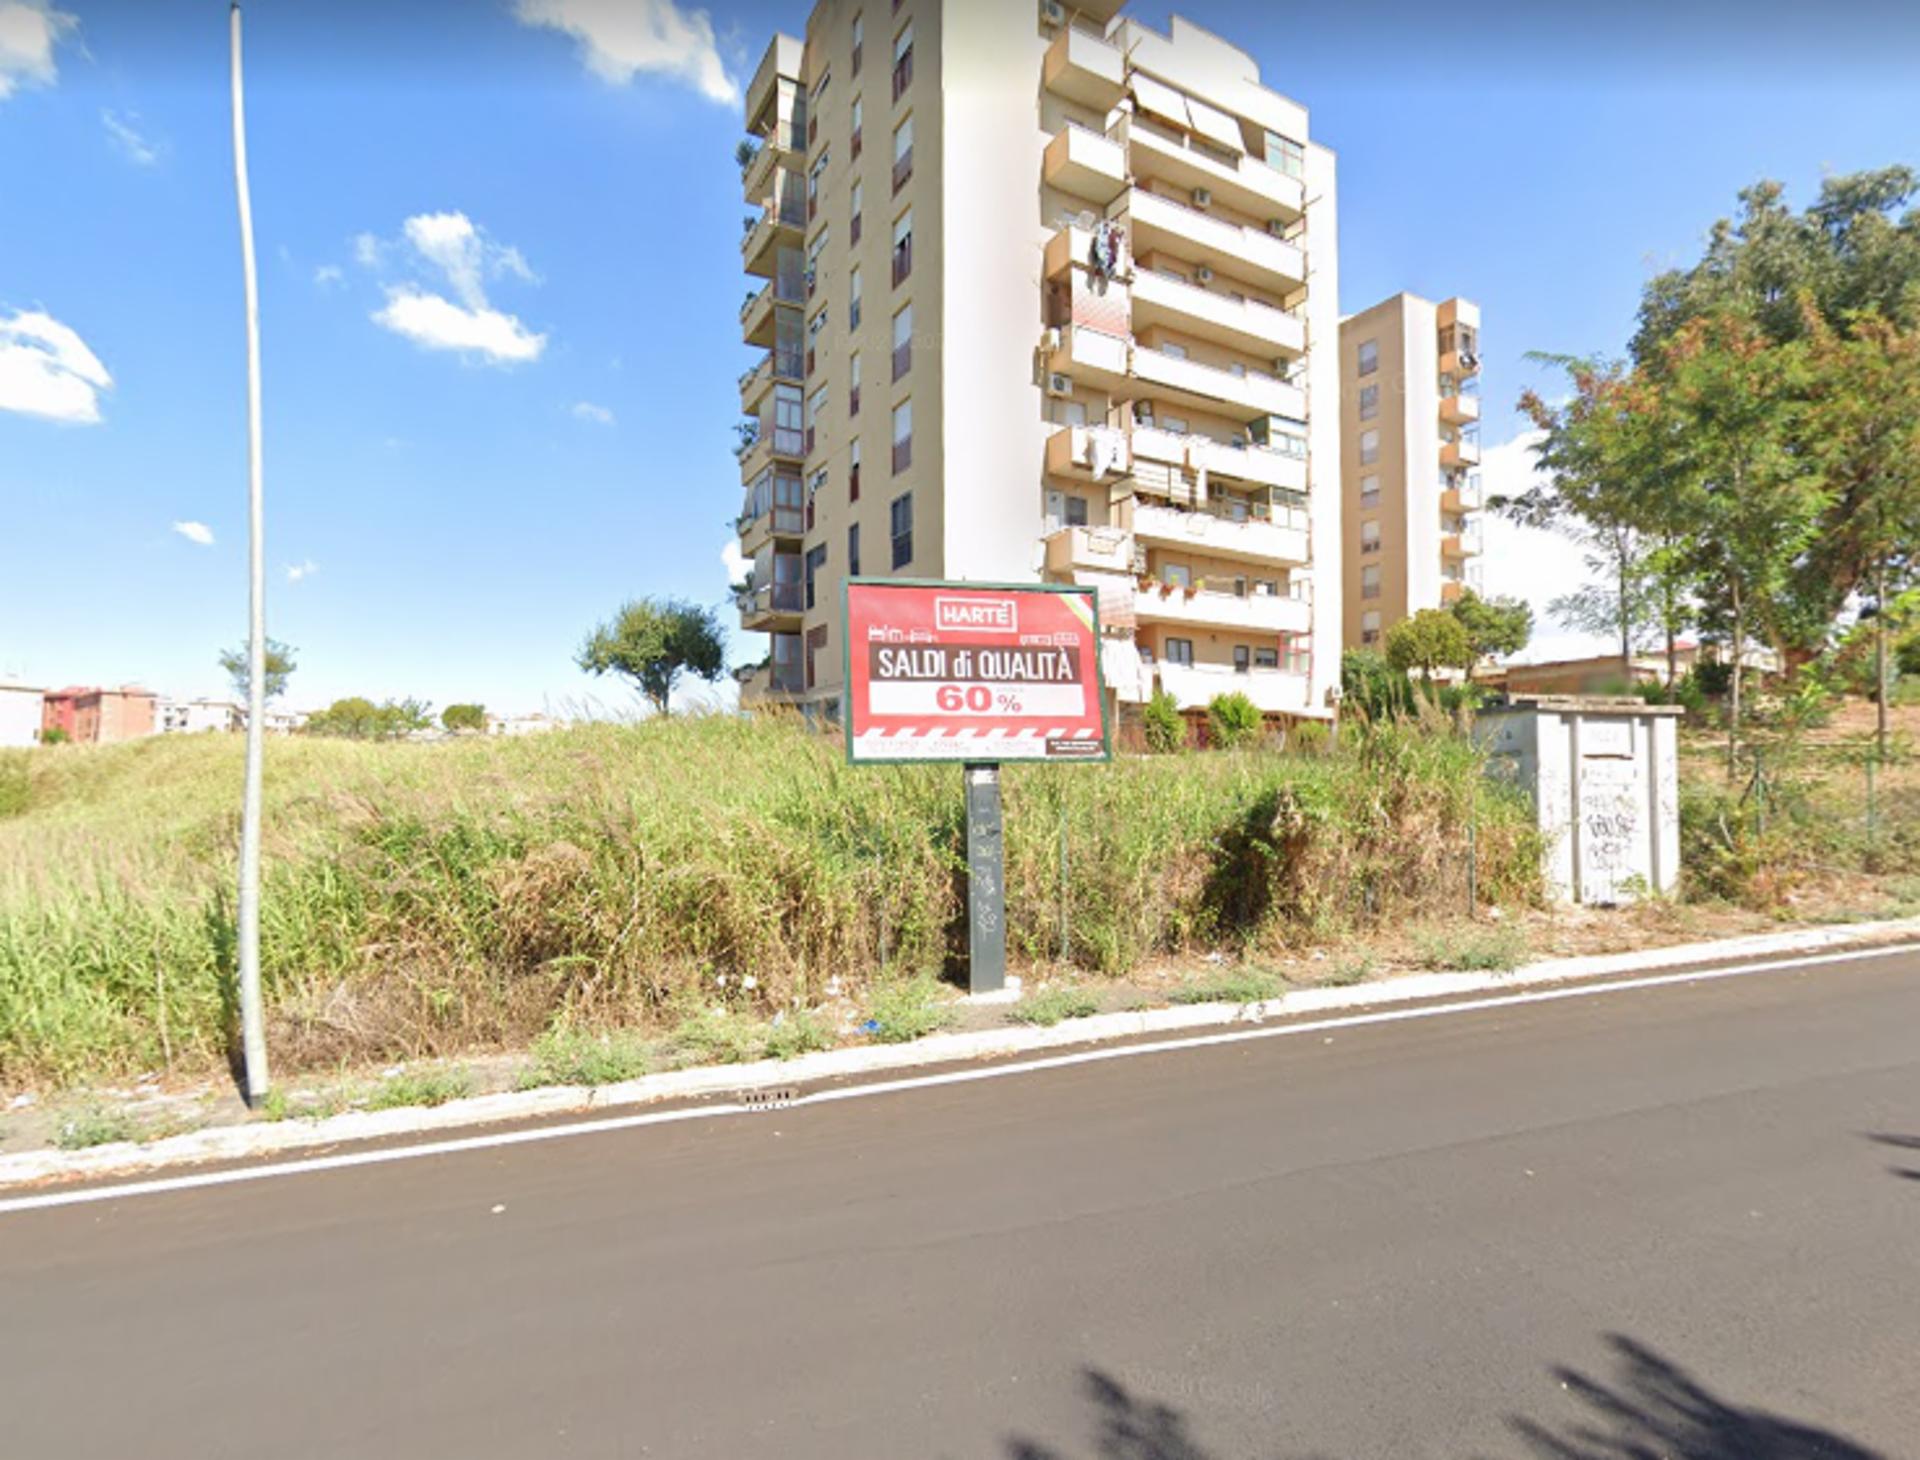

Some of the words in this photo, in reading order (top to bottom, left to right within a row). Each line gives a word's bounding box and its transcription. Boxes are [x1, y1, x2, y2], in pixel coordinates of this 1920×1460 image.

[879, 649, 946, 678] SALDI
[954, 651, 972, 678] di
[979, 647, 1073, 680] QUALITÀ
